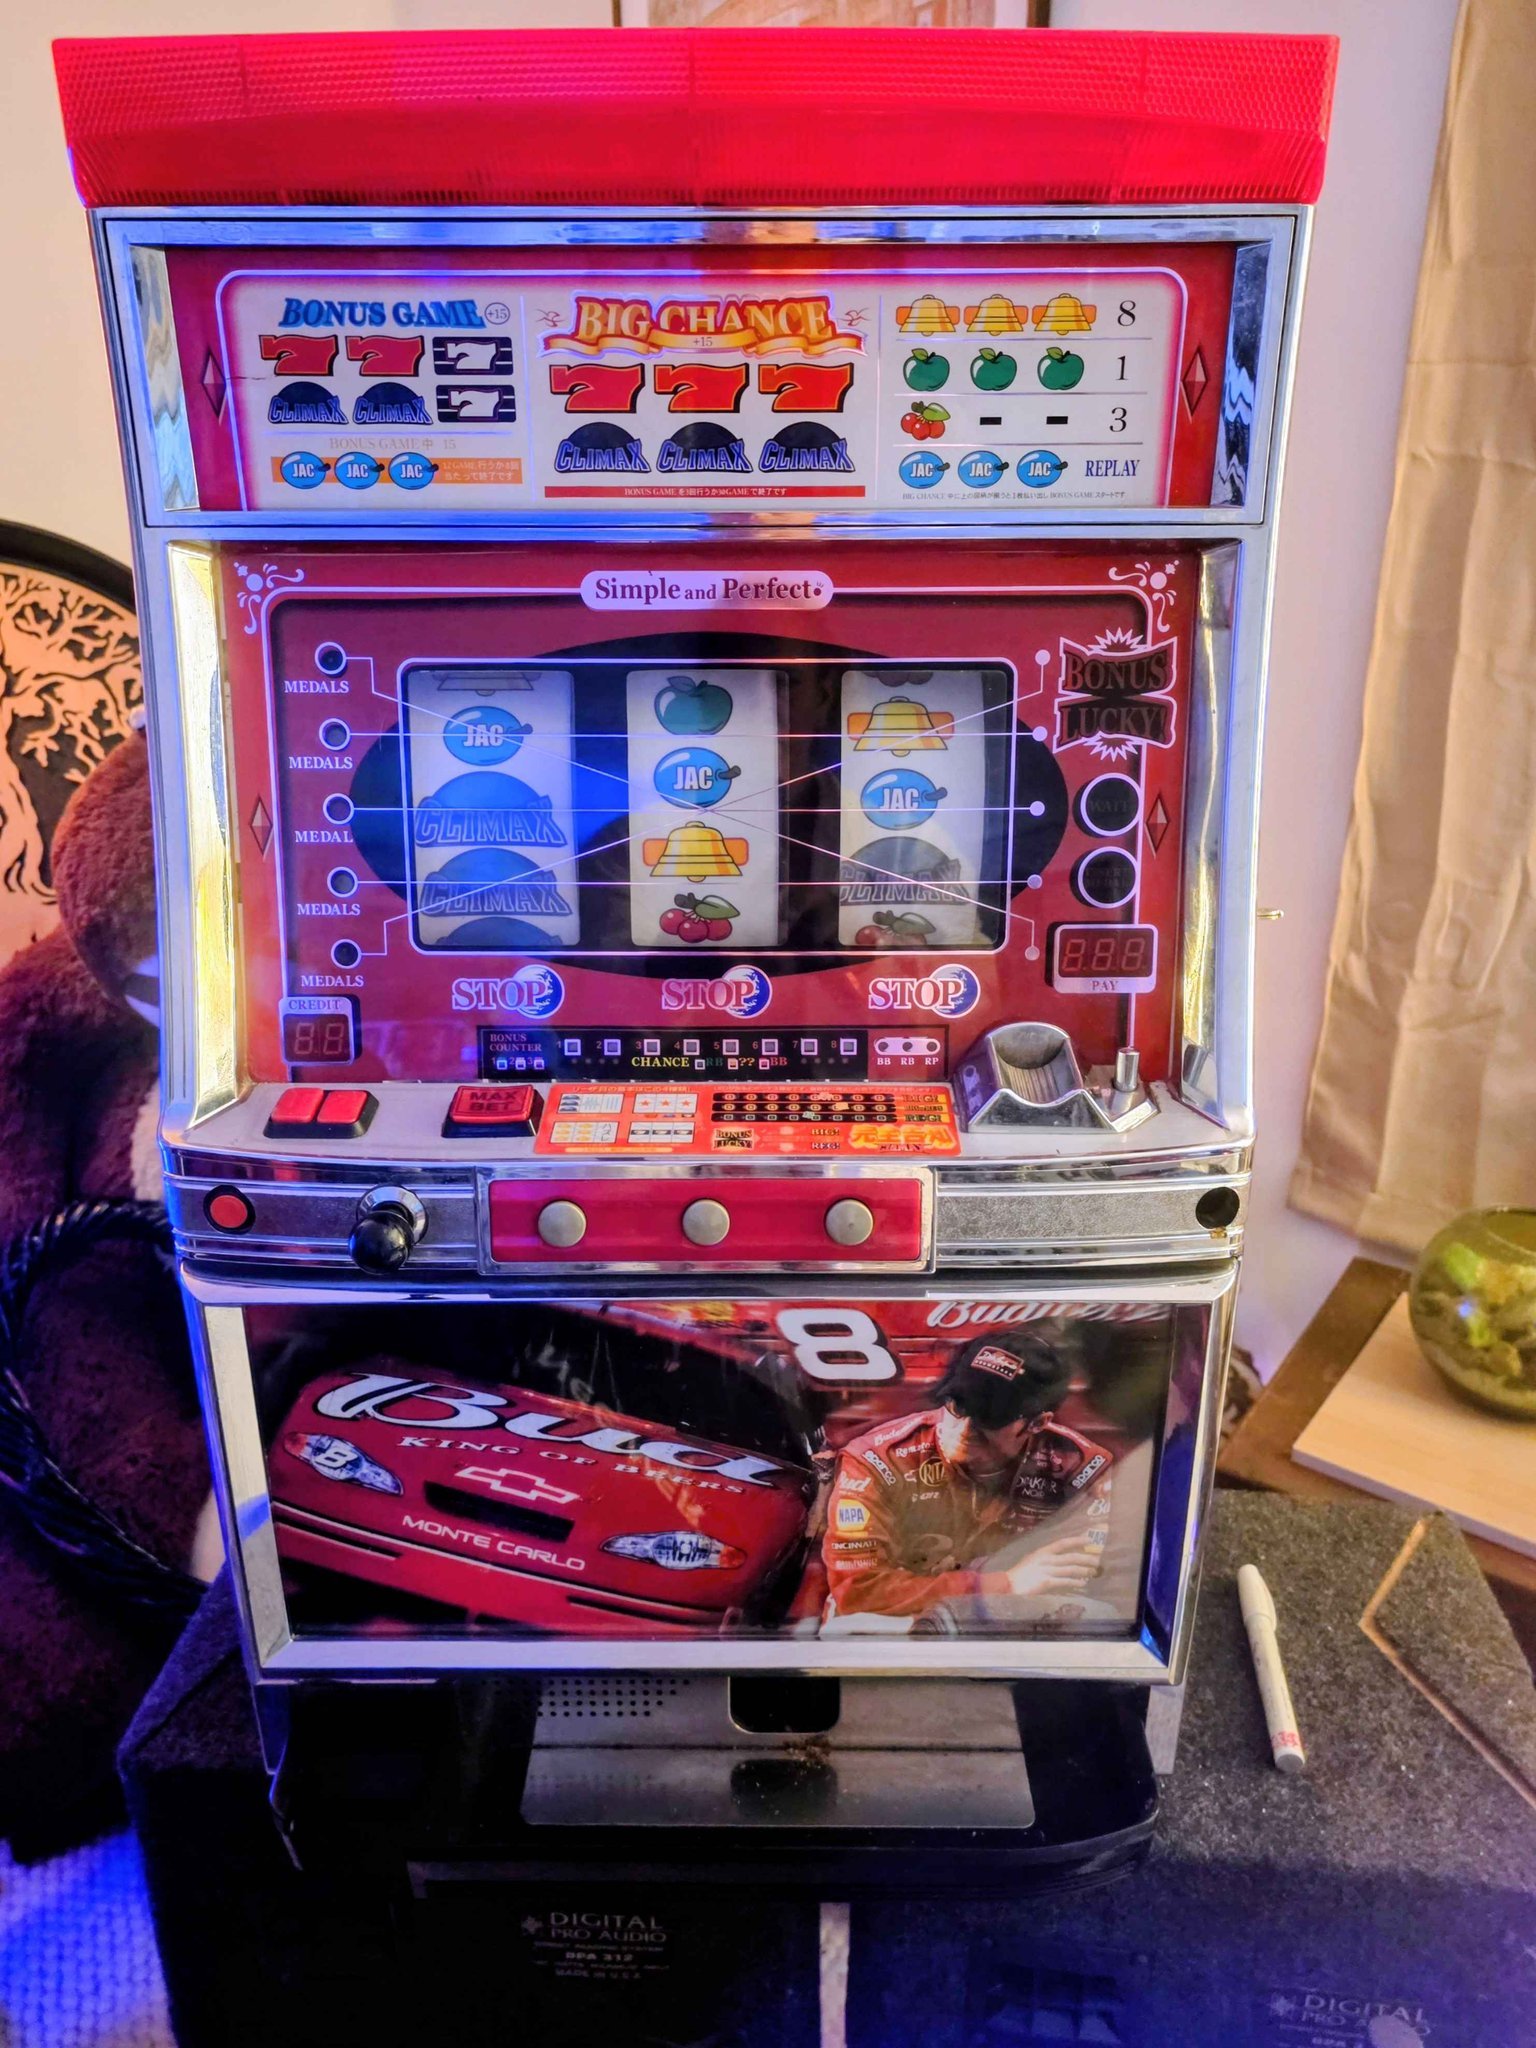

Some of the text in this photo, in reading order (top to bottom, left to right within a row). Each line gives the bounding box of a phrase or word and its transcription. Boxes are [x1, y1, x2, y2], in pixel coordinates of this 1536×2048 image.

[278, 298, 386, 327] BONUS
[391, 299, 487, 329] GAME
[576, 297, 834, 340] BIG CHANCE
[1117, 300, 1136, 327] 8
[258, 334, 498, 377] 7 7 7
[1116, 355, 1129, 381] 1
[549, 363, 854, 413] 7 7 7
[268, 388, 501, 425] CLIMAX CLIMAX 7
[1110, 407, 1128, 433] 3
[329, 438, 375, 450] BONUS
[443, 439, 456, 450] 15
[555, 439, 856, 473] CLIMAX CLIMAX CLIMAX
[291, 462, 423, 478] JAC JAC JAC
[910, 462, 1051, 478] JAC JAC JAC
[1085, 459, 1140, 477] REPLAY
[624, 487, 651, 497] BONUS
[652, 487, 677, 497] GAME
[595, 577, 811, 605] Simple and Perfect
[1064, 650, 1168, 690] BONUS
[284, 680, 350, 694] MEDALS
[464, 723, 505, 748] JAC
[288, 756, 353, 769] MEDALS
[673, 766, 714, 790] JAC
[878, 787, 919, 811] JAC
[415, 797, 568, 848] CLIMAX
[295, 831, 354, 843] MEDAL
[420, 871, 573, 917] CLIMAX
[297, 903, 361, 916] MEDALS
[301, 975, 365, 987] MEDALS
[1091, 980, 1118, 991] PAY
[288, 1000, 341, 1011] CREDIT
[452, 978, 549, 1011] STOP
[661, 978, 756, 1011] STOP
[868, 977, 963, 1010] STOP
[490, 1033, 527, 1042] BONUS
[490, 1043, 542, 1052] COUNTER
[636, 1041, 642, 1050] 3
[674, 1041, 680, 1050] 4
[714, 1041, 720, 1050] 5
[752, 1041, 758, 1050] 6
[831, 1041, 837, 1050] 8
[631, 1056, 690, 1068] CHANCE
[770, 1056, 788, 1067] BB
[877, 1057, 939, 1066] BB RB RP
[470, 1091, 517, 1101] MAX
[716, 1129, 753, 1138] BONUS
[776, 1308, 900, 1383] 8
[313, 1371, 785, 1488] Bud
[314, 1446, 350, 1469] 8
[397, 1434, 746, 1494] KING OF BEERS
[1071, 1454, 1107, 1489] sparco
[839, 1507, 866, 1524] NAPA
[402, 1514, 586, 1572] MONTE CARLO
[550, 1911, 663, 1930] DIGITAL
[551, 1928, 667, 1943] PRO AUDIO
